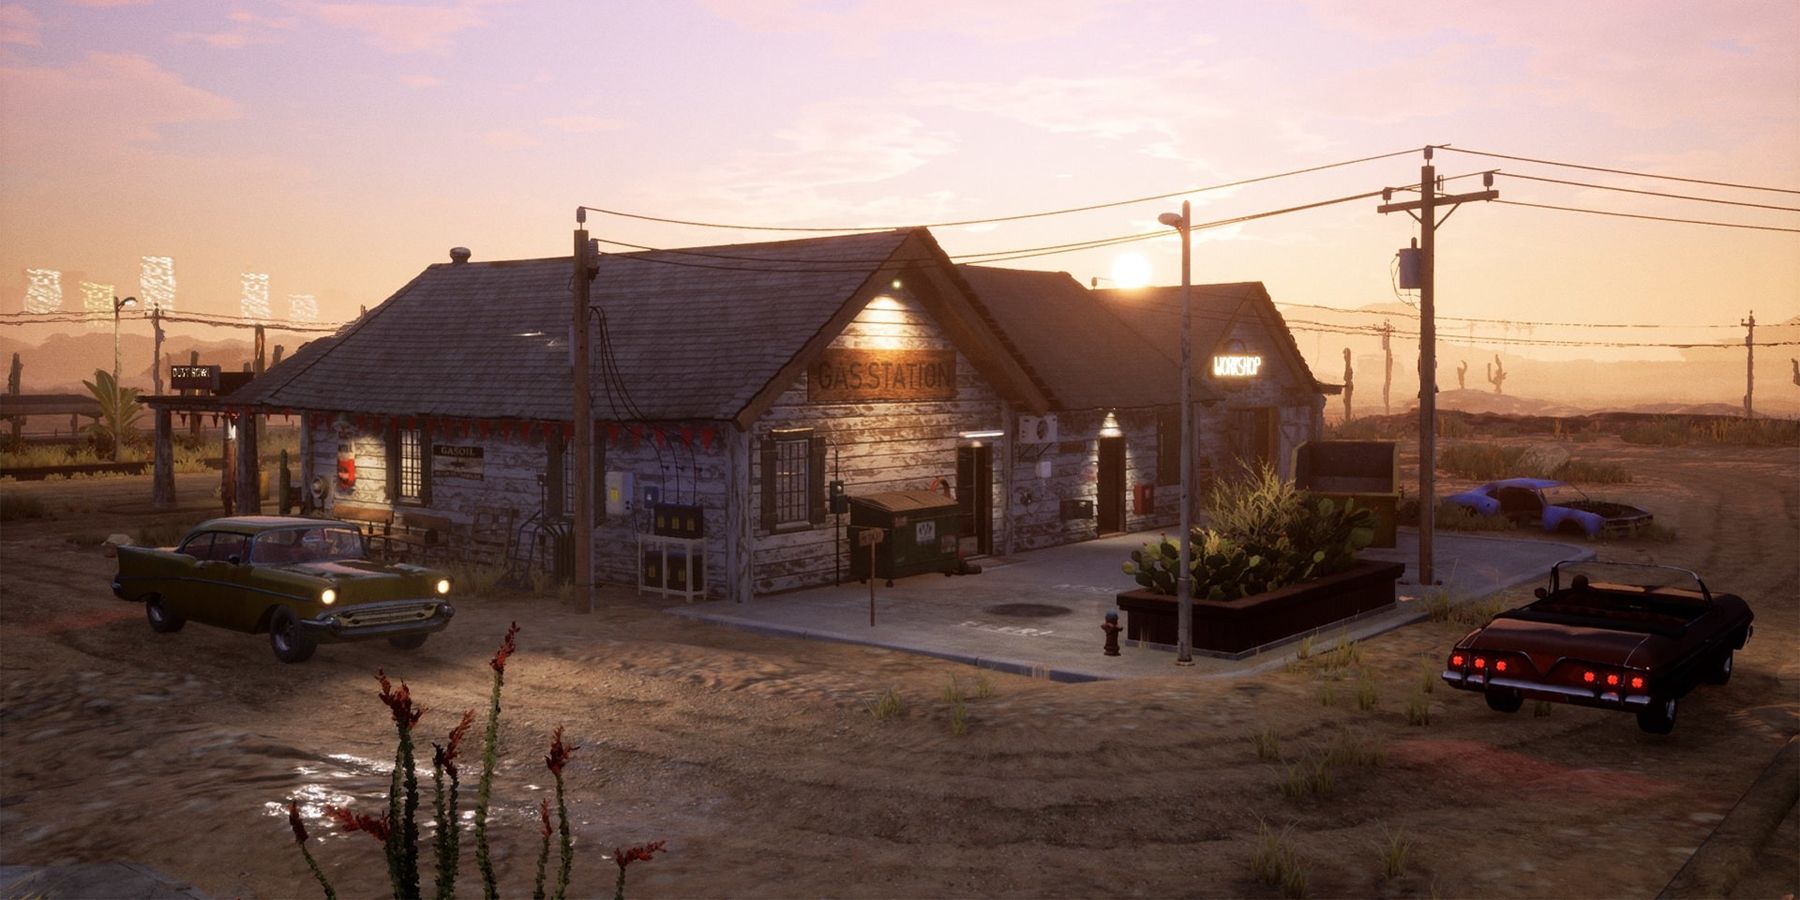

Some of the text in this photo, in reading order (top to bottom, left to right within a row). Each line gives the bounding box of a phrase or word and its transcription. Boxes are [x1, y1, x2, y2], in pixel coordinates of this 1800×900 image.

[817, 360, 951, 390] GAS STATION
[1213, 355, 1262, 376] WORKSHOP
[440, 446, 475, 457] GASOIL
